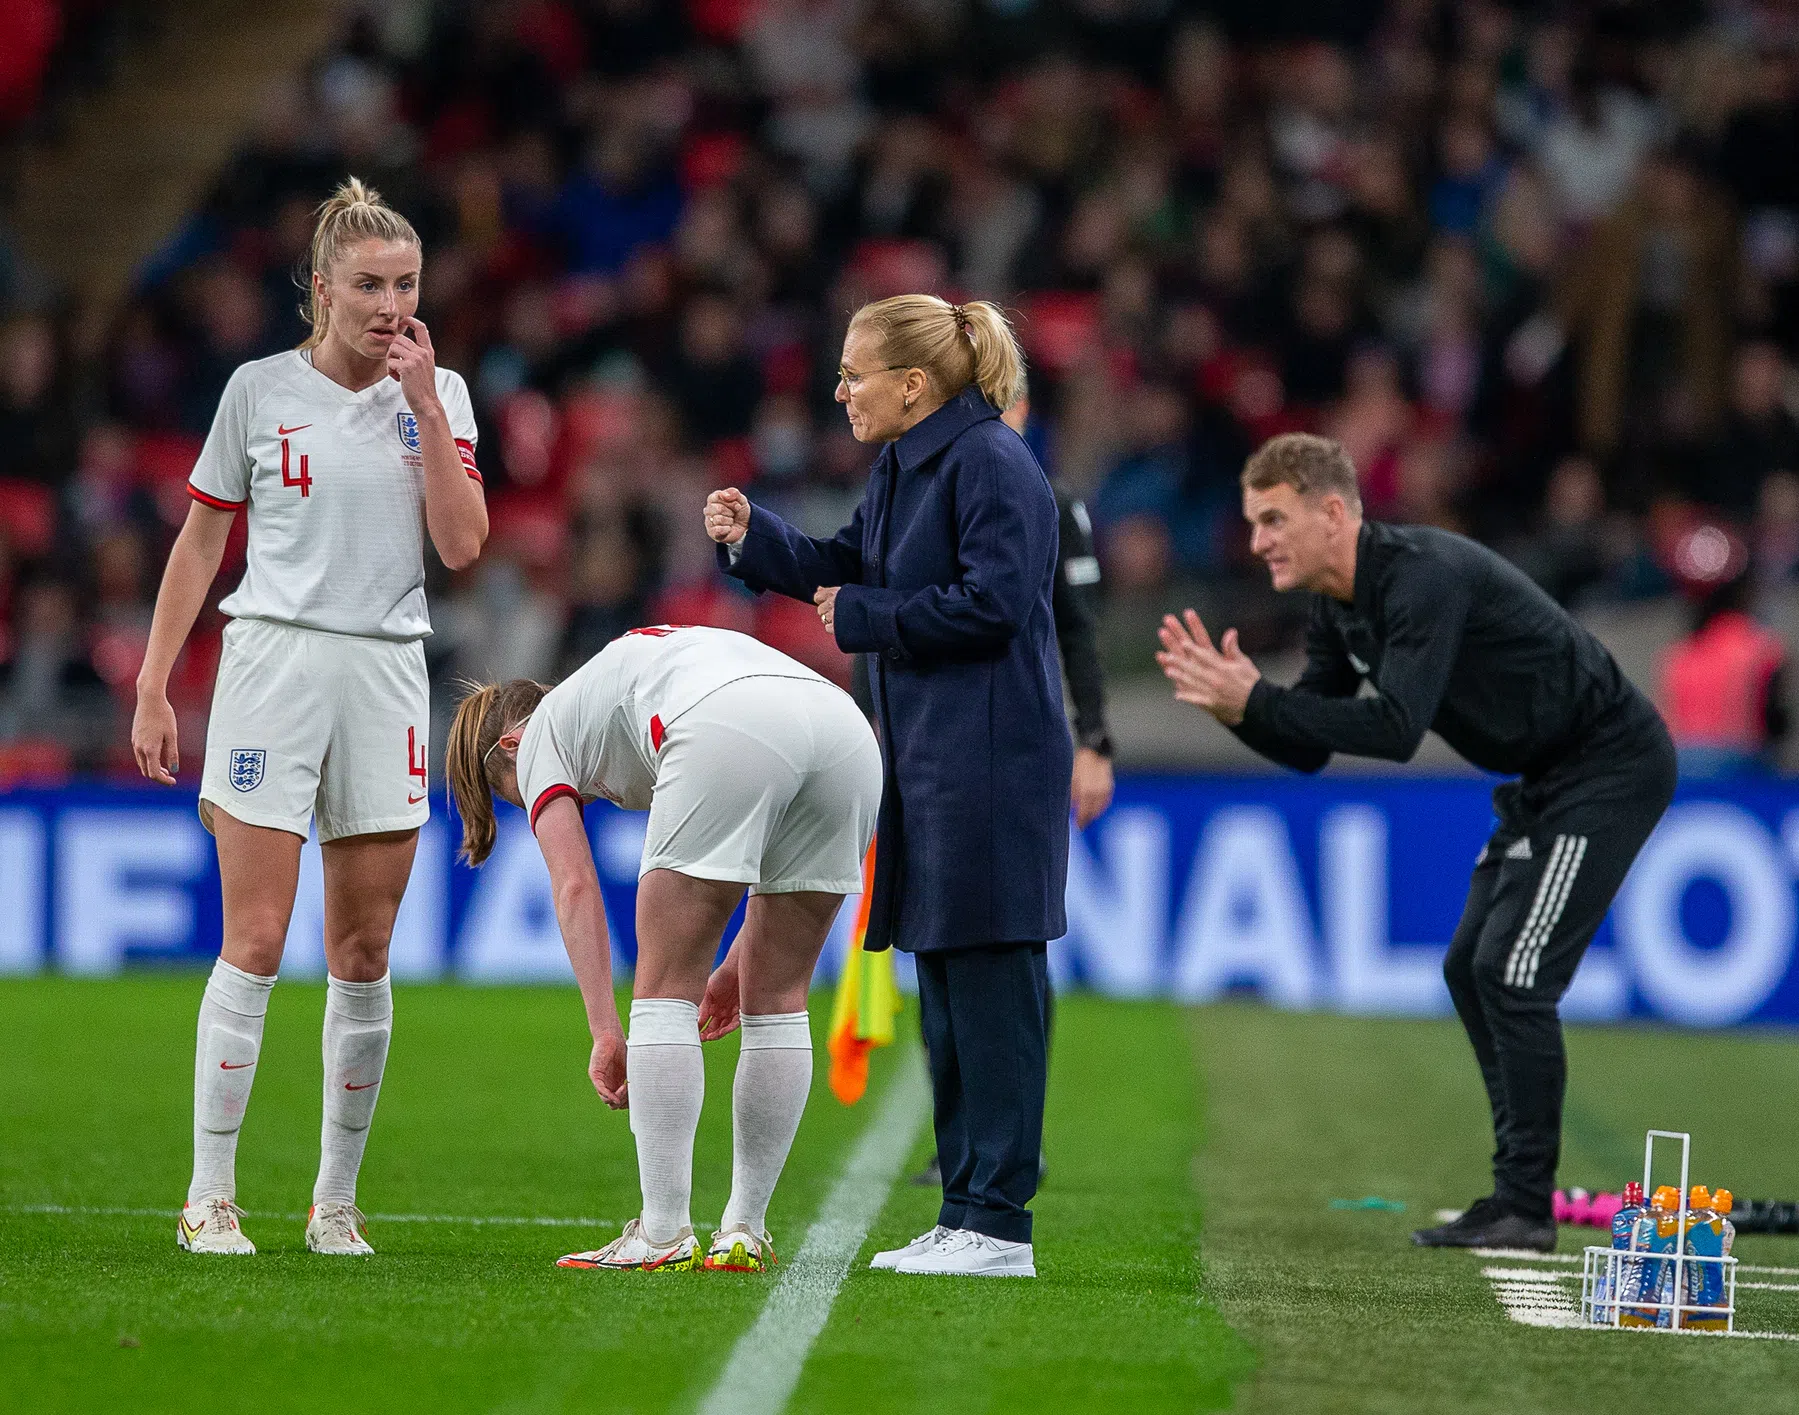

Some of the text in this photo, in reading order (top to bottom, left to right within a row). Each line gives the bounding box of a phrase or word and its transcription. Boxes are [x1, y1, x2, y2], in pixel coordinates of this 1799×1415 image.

[282, 438, 313, 498] 4
[408, 725, 427, 788] 4
[1687, 1246, 1699, 1301] LUCOZA
